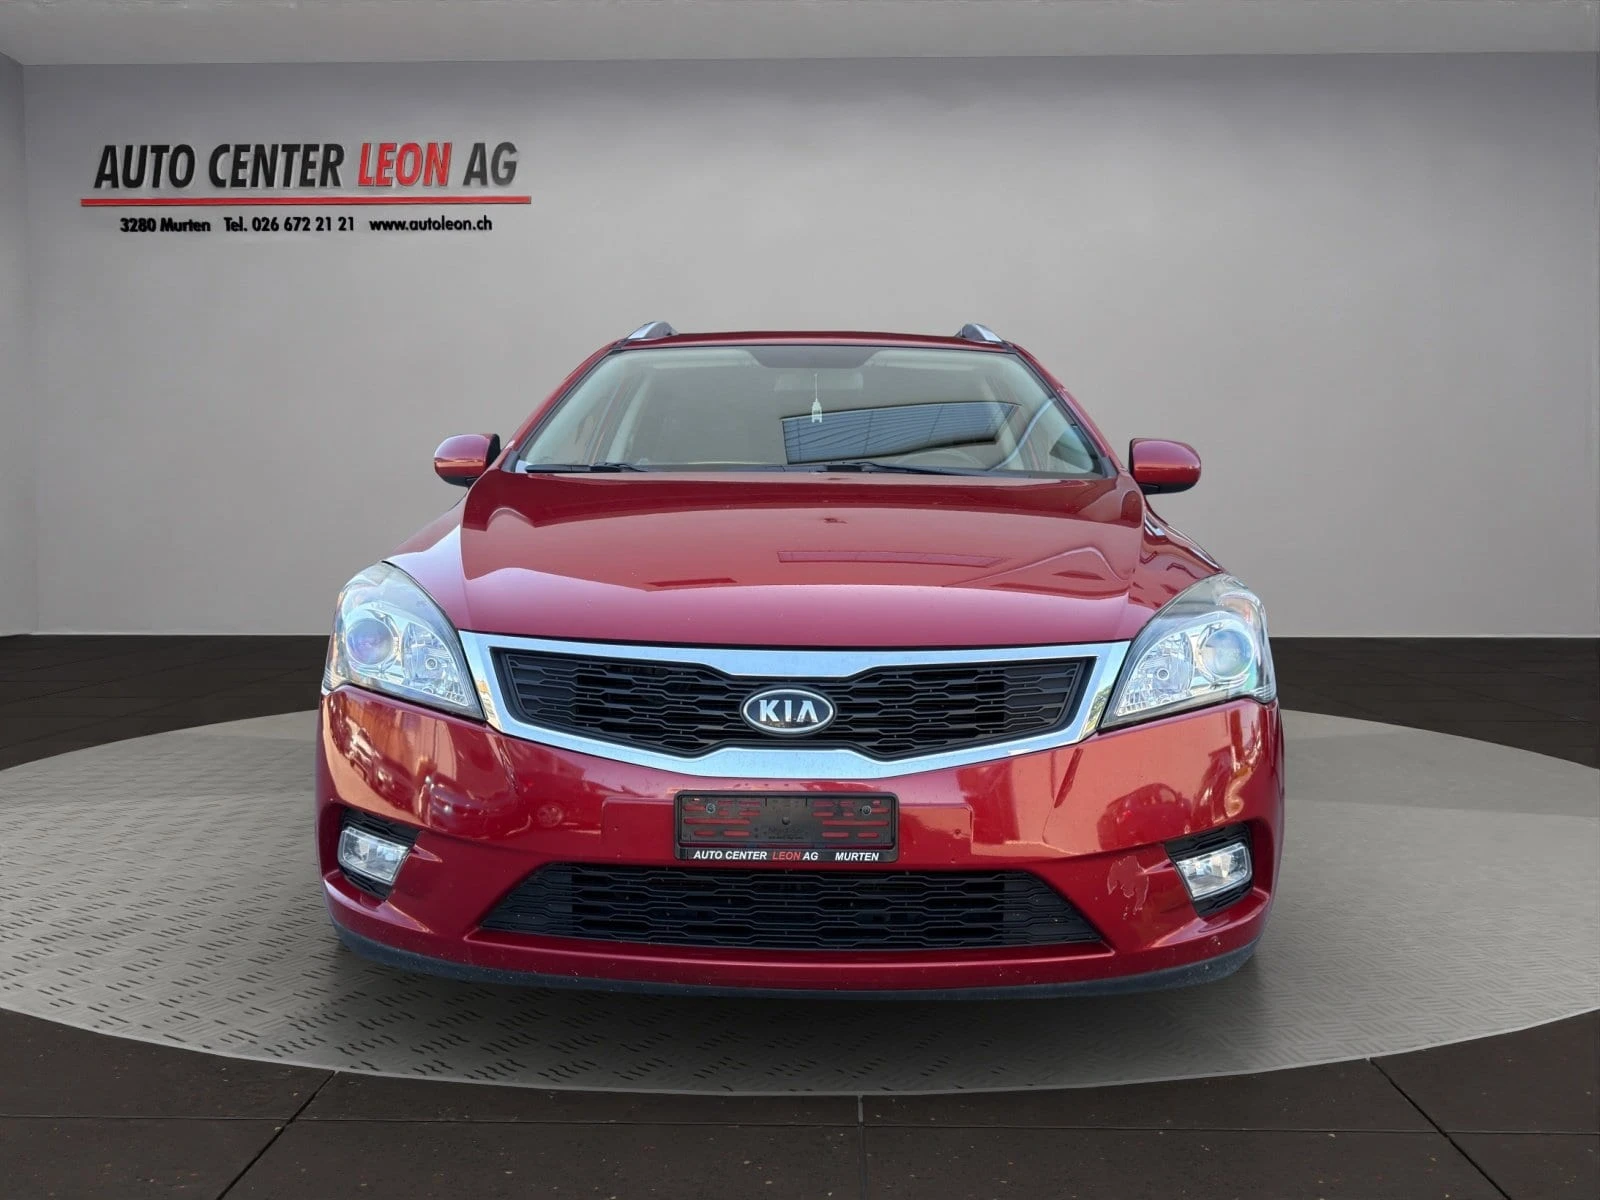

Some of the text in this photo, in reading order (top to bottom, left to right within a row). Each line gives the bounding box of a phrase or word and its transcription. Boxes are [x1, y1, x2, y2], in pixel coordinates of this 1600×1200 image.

[94, 141, 518, 189] AUTO CENTER LEON AG
[120, 215, 493, 233] 3280 Murten Tel. 026 672 21 21 www.autoleon.ch
[758, 699, 819, 723] KIA
[693, 850, 880, 862] AUTO CENTER LEON AG MURTEN
